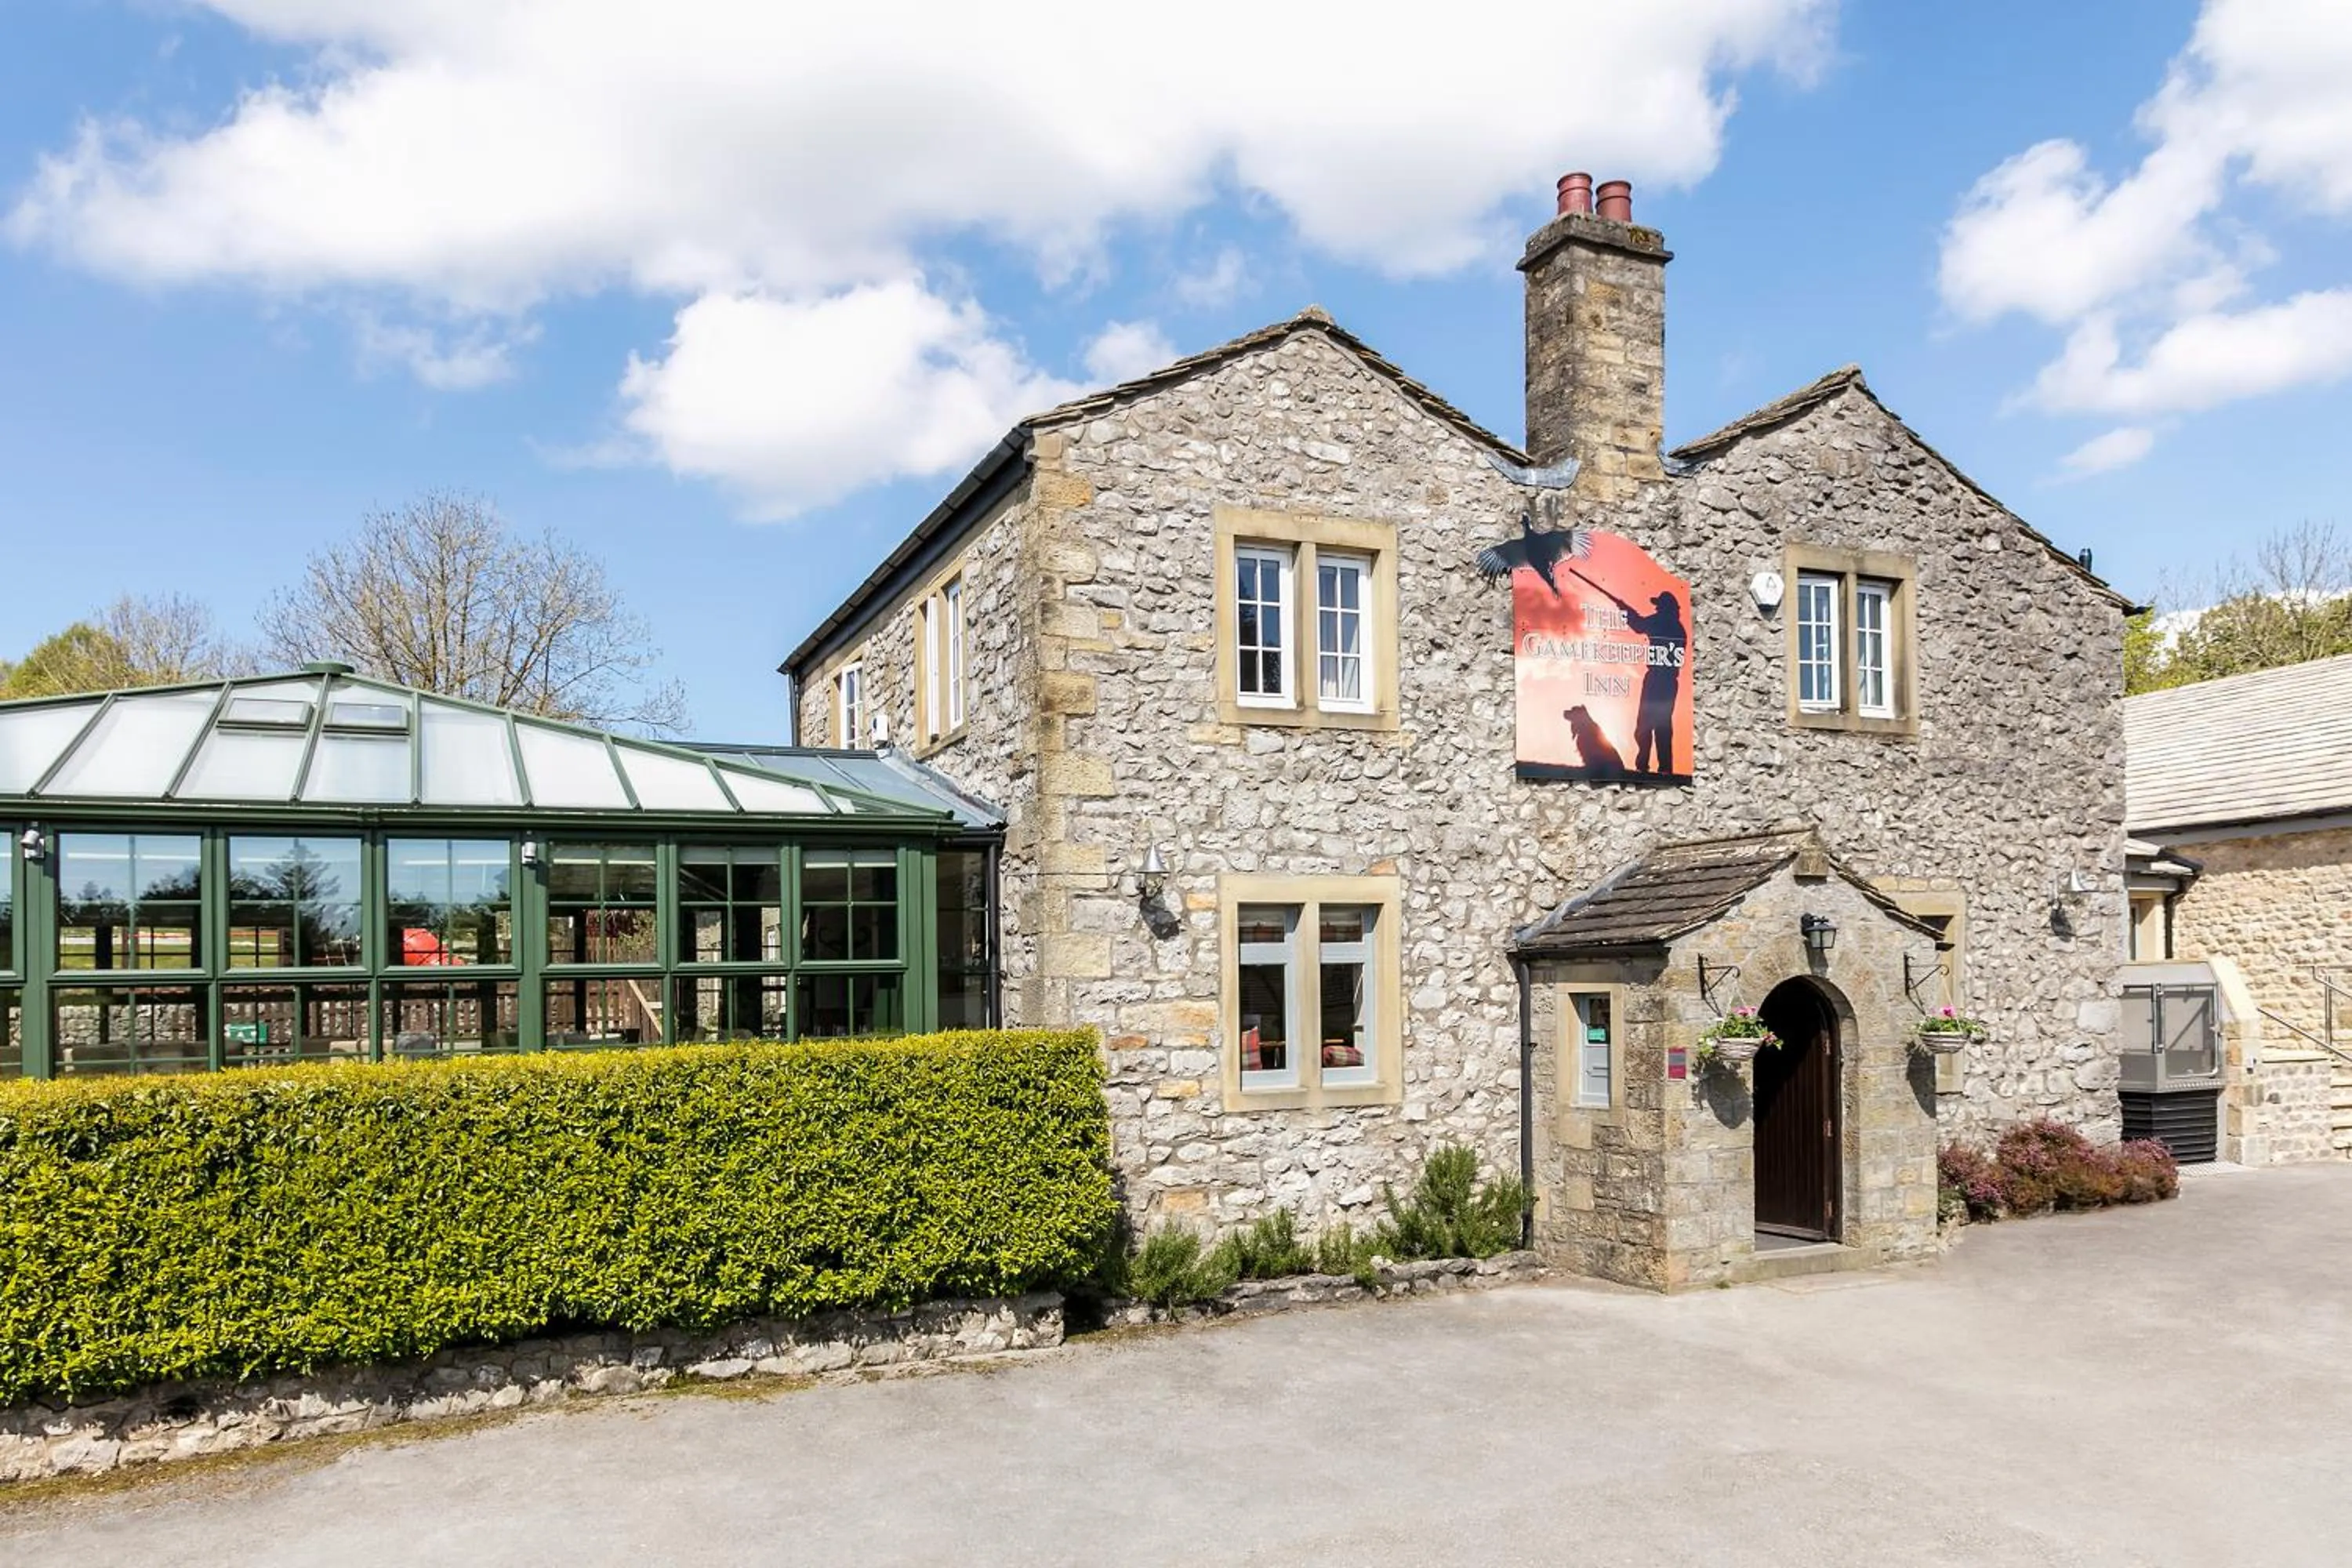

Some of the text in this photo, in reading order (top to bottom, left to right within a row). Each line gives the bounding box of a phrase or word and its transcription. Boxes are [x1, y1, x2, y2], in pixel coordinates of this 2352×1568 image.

[1581, 604, 1628, 630] THE
[1523, 633, 1685, 666] GAMEKEEPER'S
[1584, 671, 1630, 696] INN
